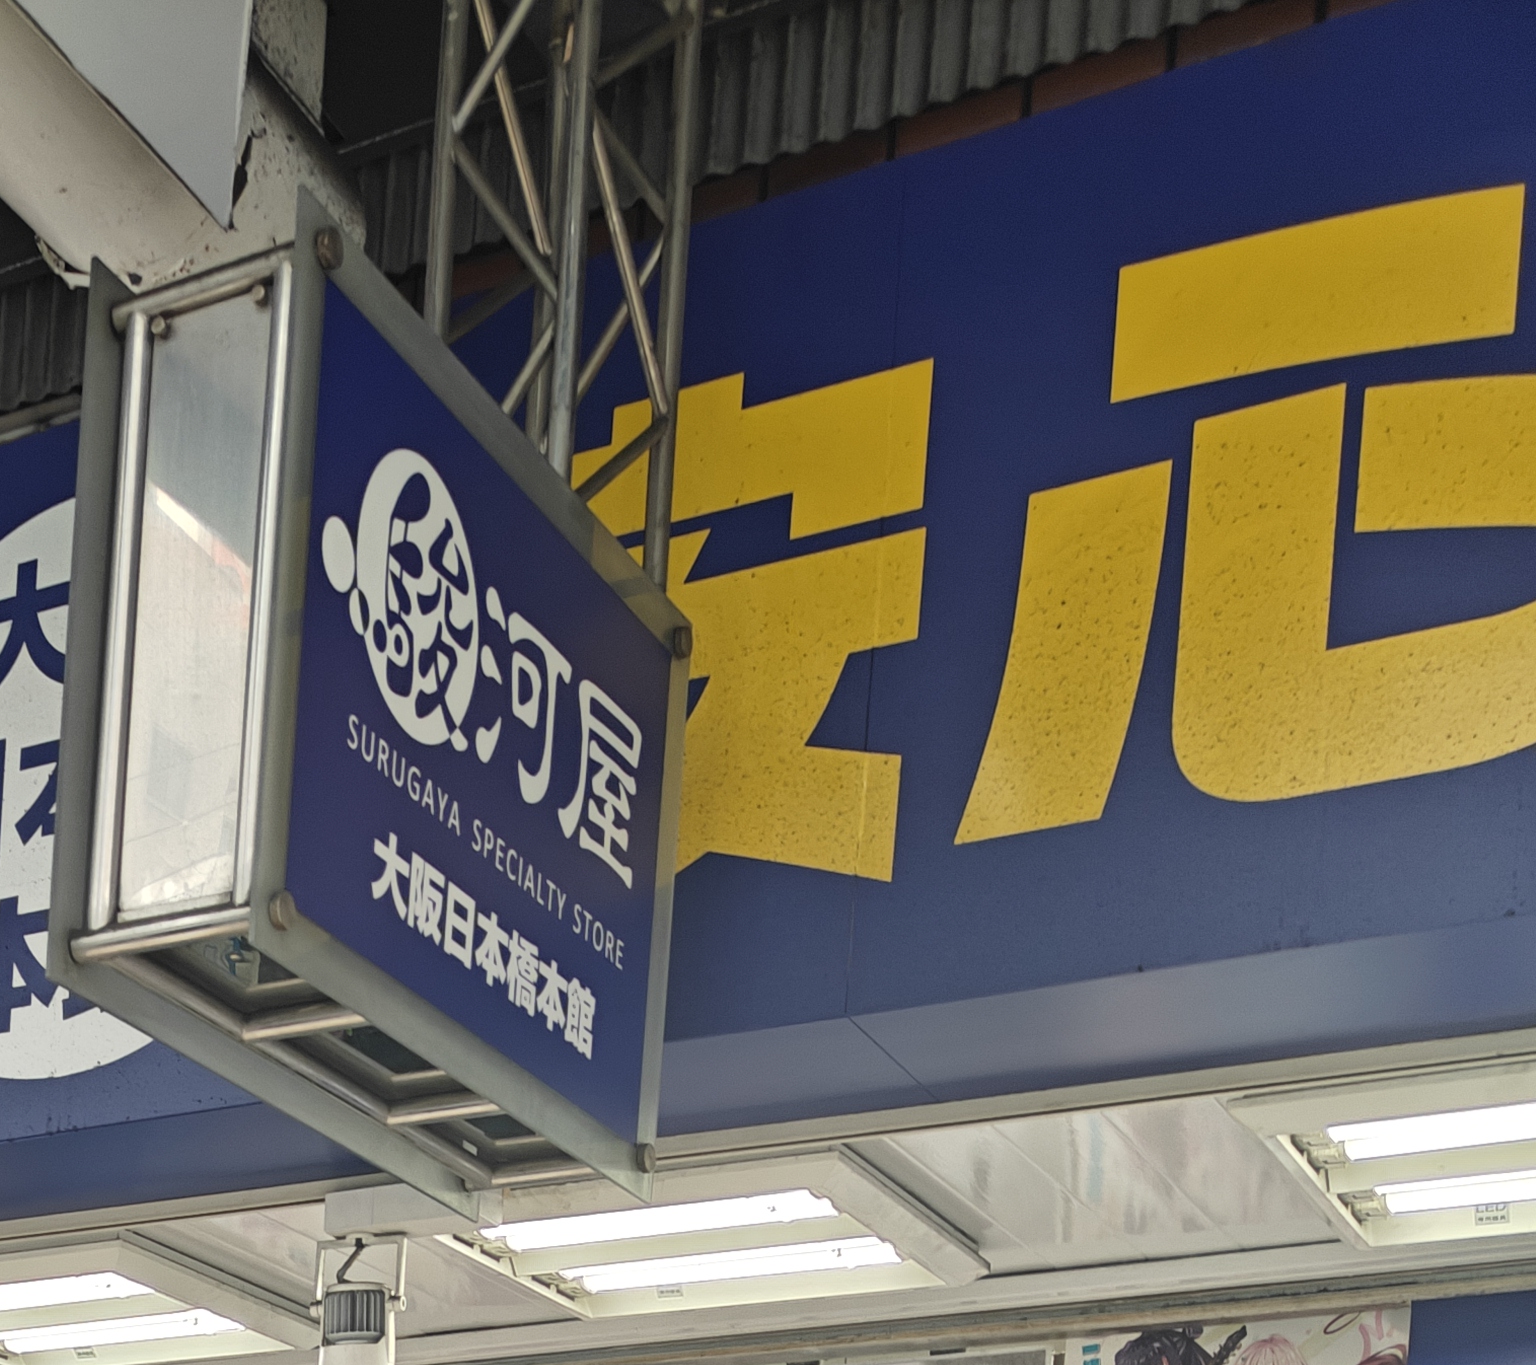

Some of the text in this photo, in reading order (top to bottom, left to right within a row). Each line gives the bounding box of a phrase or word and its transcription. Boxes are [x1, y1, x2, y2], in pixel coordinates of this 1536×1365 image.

[322, 448, 642, 889] 駿河屋
[348, 711, 626, 987] SURUGAYA SPECIALTY STORE
[371, 832, 597, 1060] 大阪日本橋本館
